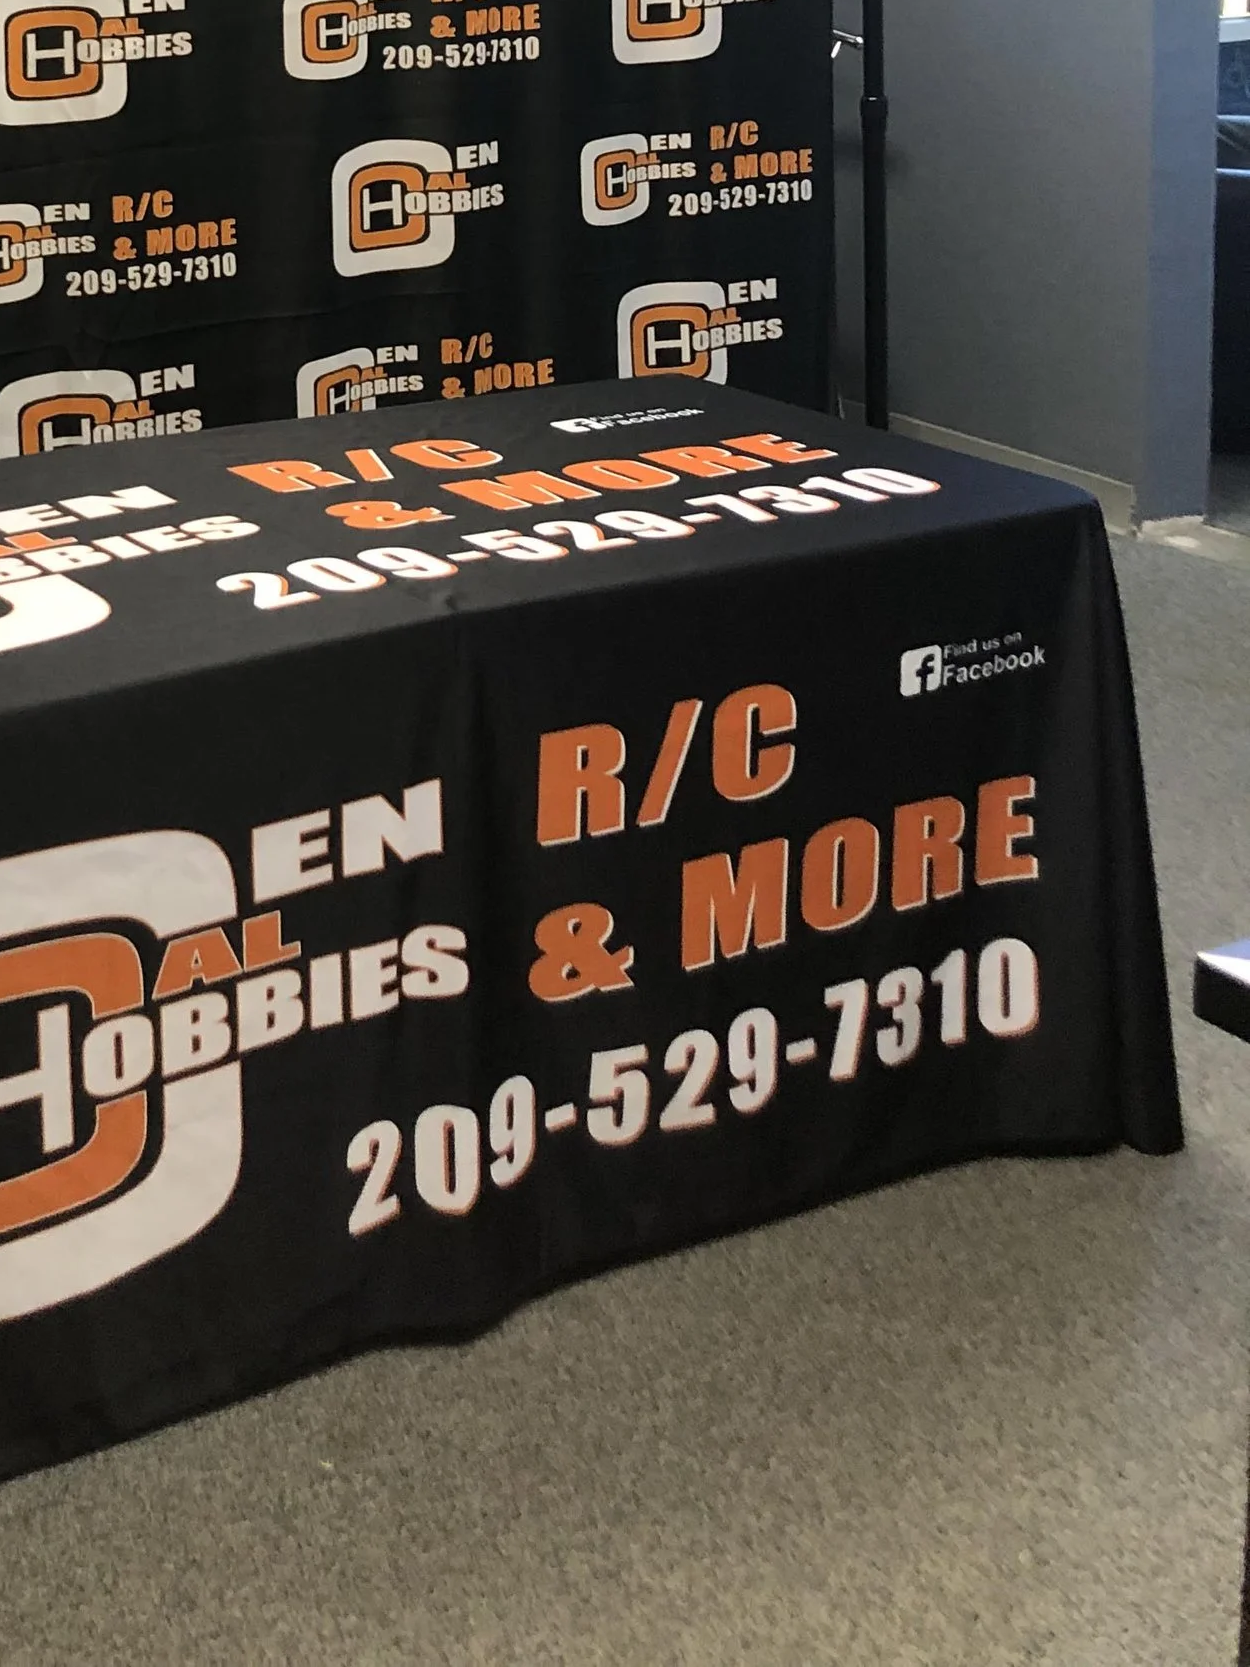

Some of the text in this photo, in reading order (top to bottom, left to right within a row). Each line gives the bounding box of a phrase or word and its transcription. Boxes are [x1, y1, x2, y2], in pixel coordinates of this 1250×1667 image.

[430, 4, 538, 37] & MORE
[383, 36, 539, 69] 209-529-7310
[710, 122, 758, 149] R/C
[712, 151, 810, 182] & MORE
[113, 190, 171, 223] R/C
[669, 179, 812, 216] 209-529-7310
[113, 218, 234, 259] & MORE
[66, 253, 236, 296] 209-529-7310
[441, 334, 490, 362] R/C
[442, 360, 552, 398] & MORE
[600, 407, 705, 427] Facebook
[227, 439, 503, 494] R/C
[325, 433, 838, 530] & MORE
[216, 468, 942, 610] 209-529-7310
[943, 632, 1023, 659] Find us on
[943, 645, 1046, 686] Facebook
[537, 684, 797, 846] R/C
[529, 775, 1039, 1002] & MORE
[347, 937, 1040, 1237] 209-529-7310
